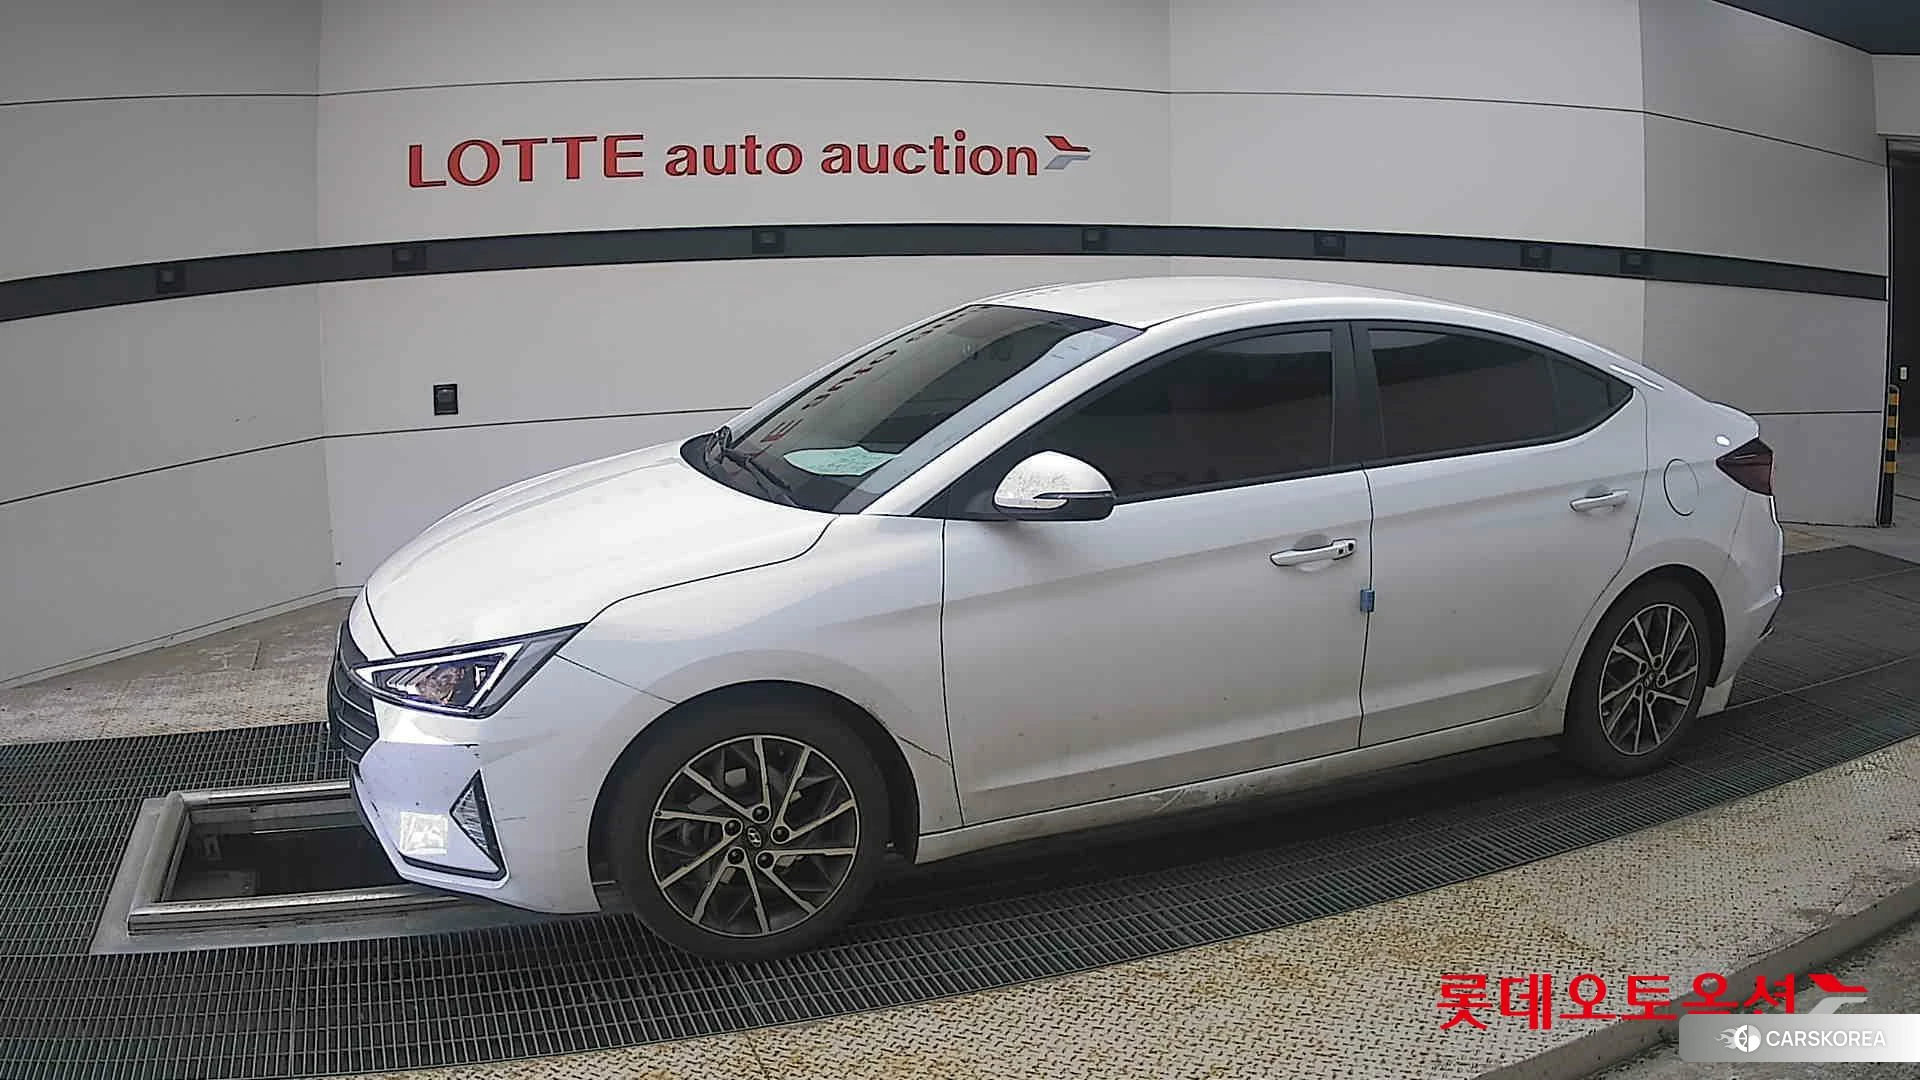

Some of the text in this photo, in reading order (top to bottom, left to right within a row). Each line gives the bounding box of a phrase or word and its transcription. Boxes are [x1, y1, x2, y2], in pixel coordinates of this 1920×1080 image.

[408, 129, 1038, 188] LOTTE auto auction
